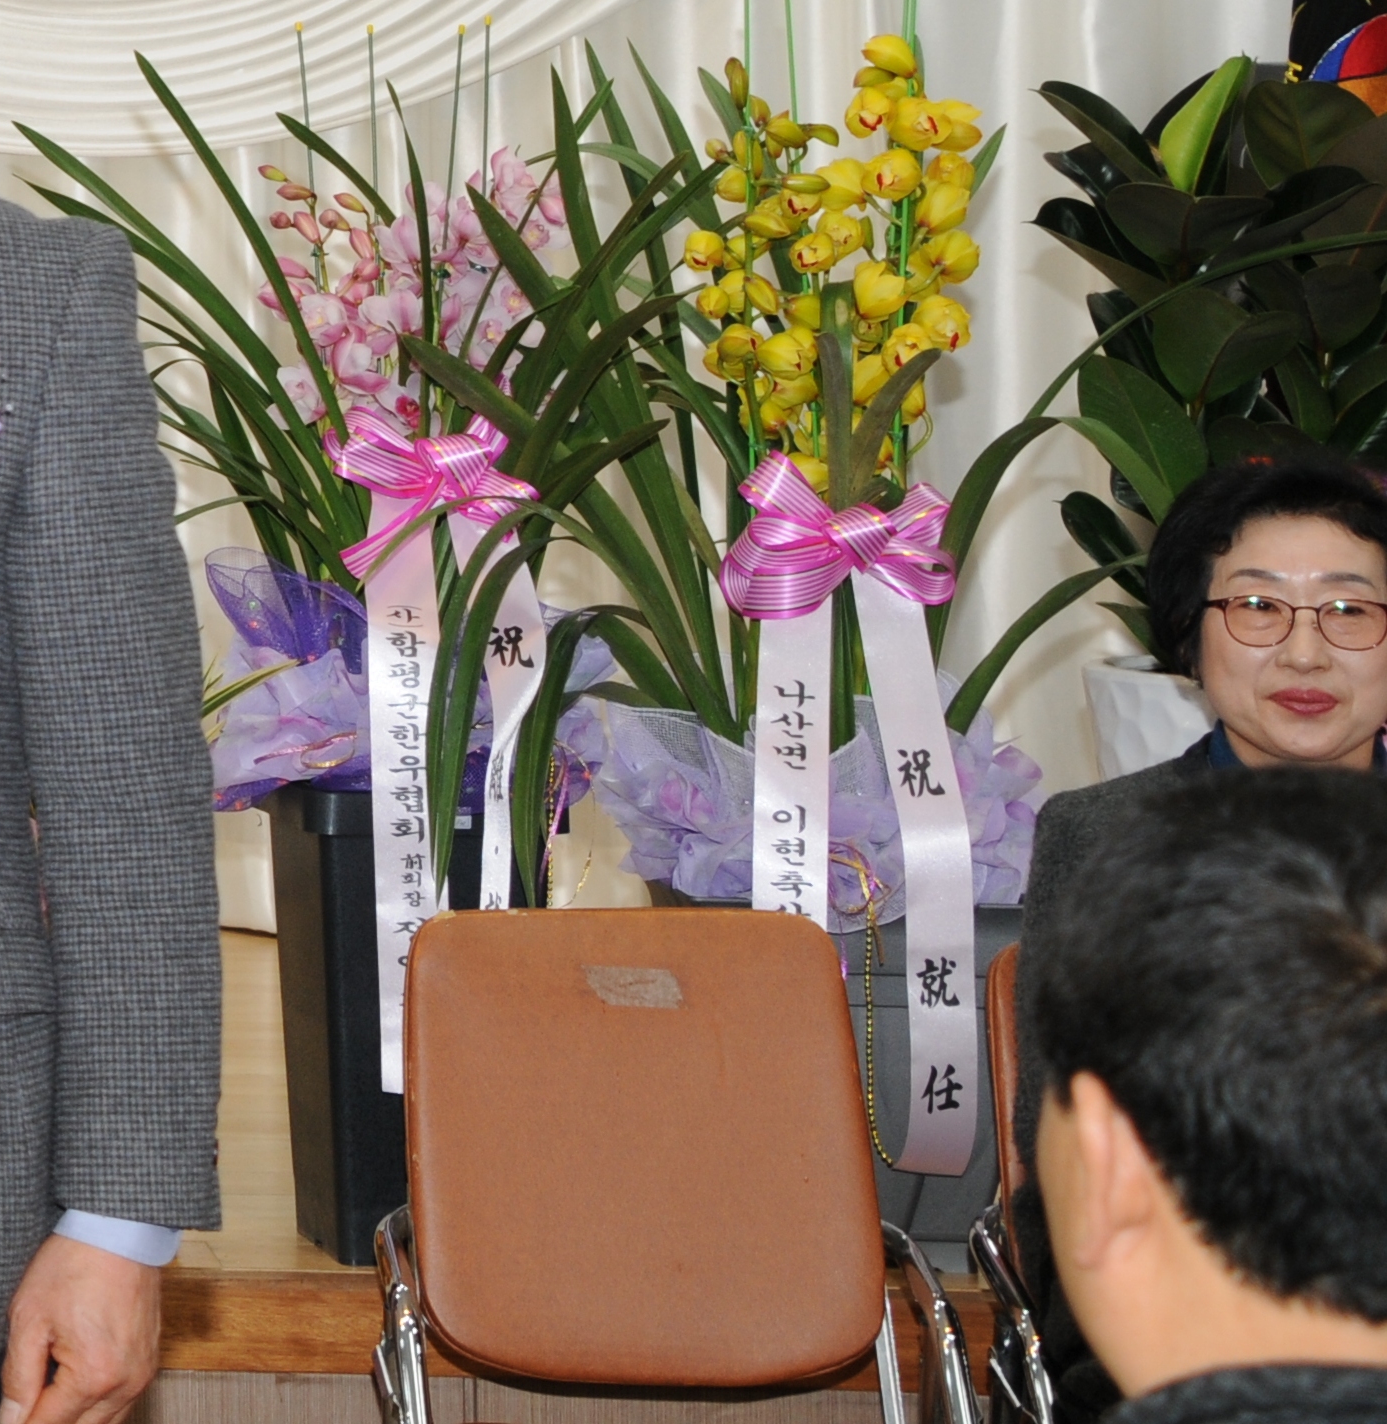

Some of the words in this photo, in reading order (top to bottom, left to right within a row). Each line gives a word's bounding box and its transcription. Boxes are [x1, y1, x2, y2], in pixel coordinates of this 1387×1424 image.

[486, 625, 536, 670] 祝
[770, 679, 817, 771] 나산면
[896, 746, 946, 799] 祝
